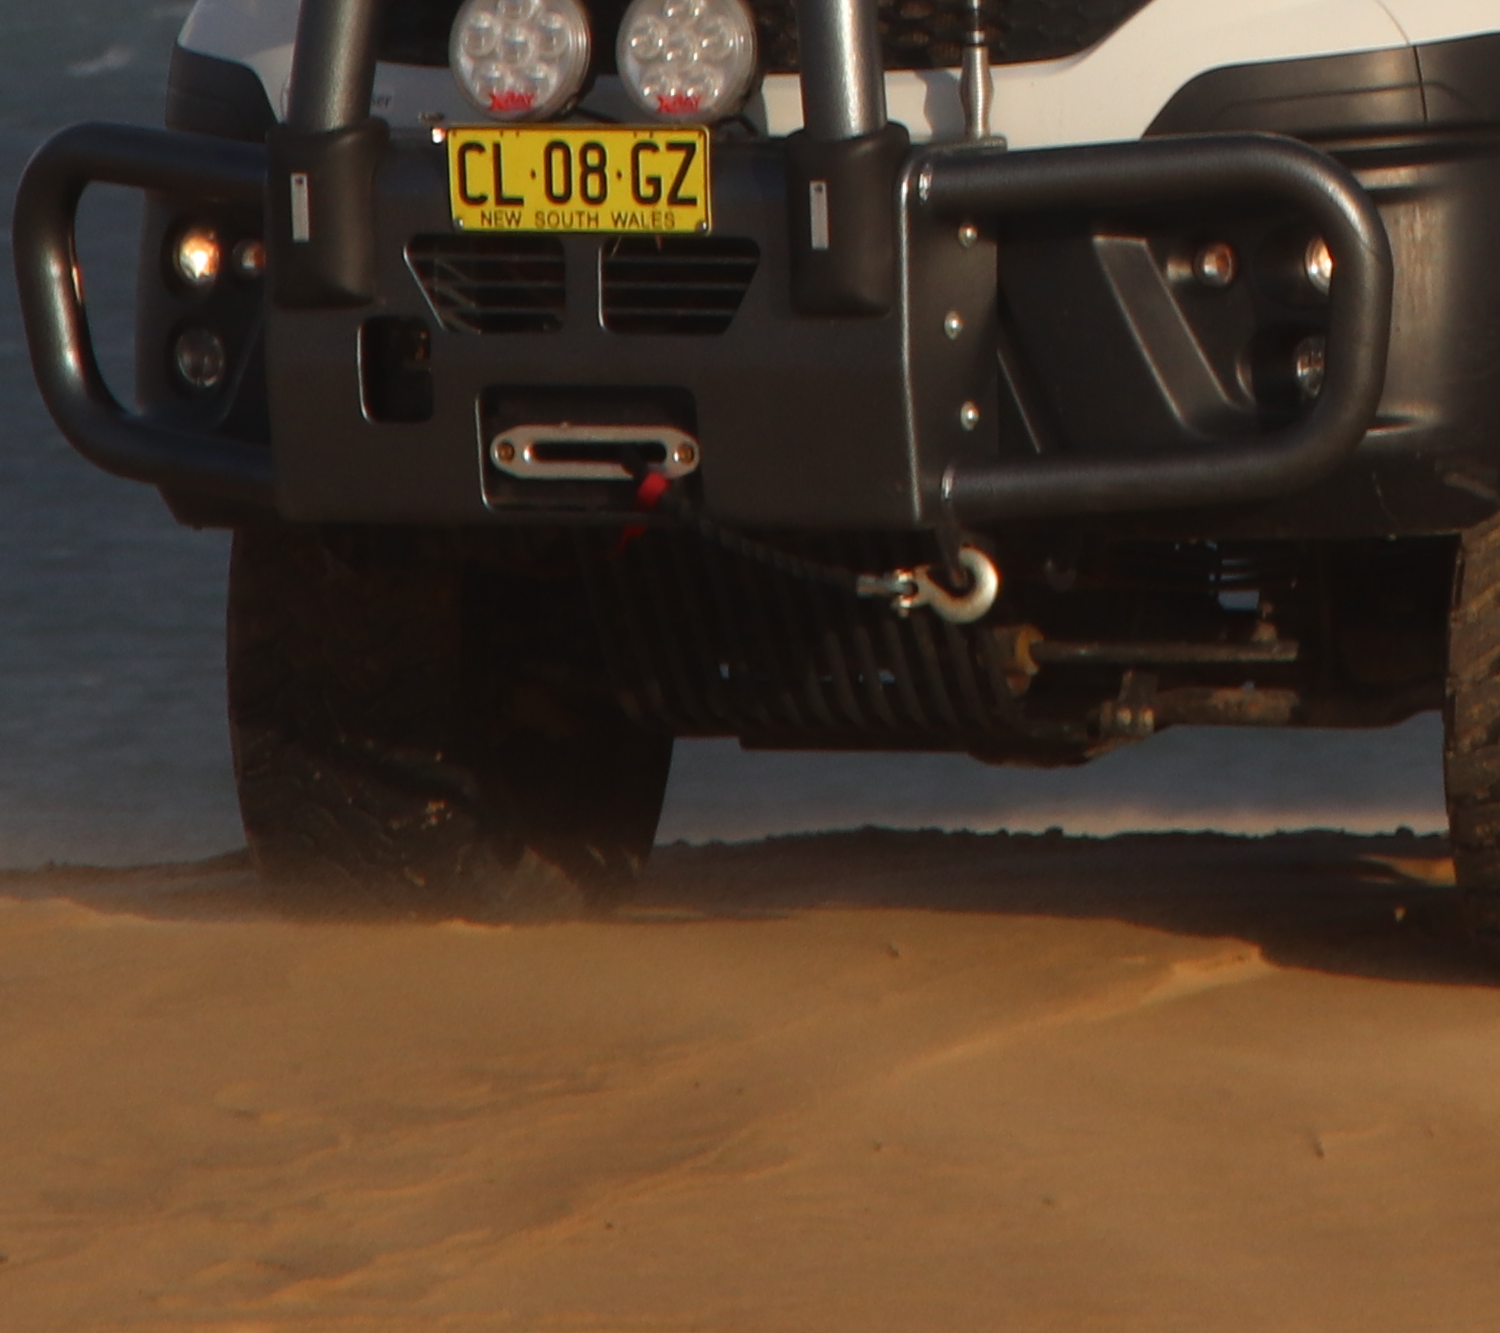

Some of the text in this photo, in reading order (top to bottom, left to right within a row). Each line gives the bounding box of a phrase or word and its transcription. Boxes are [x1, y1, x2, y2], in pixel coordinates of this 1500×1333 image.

[480, 209, 676, 230] NEW SOUTH WALES
